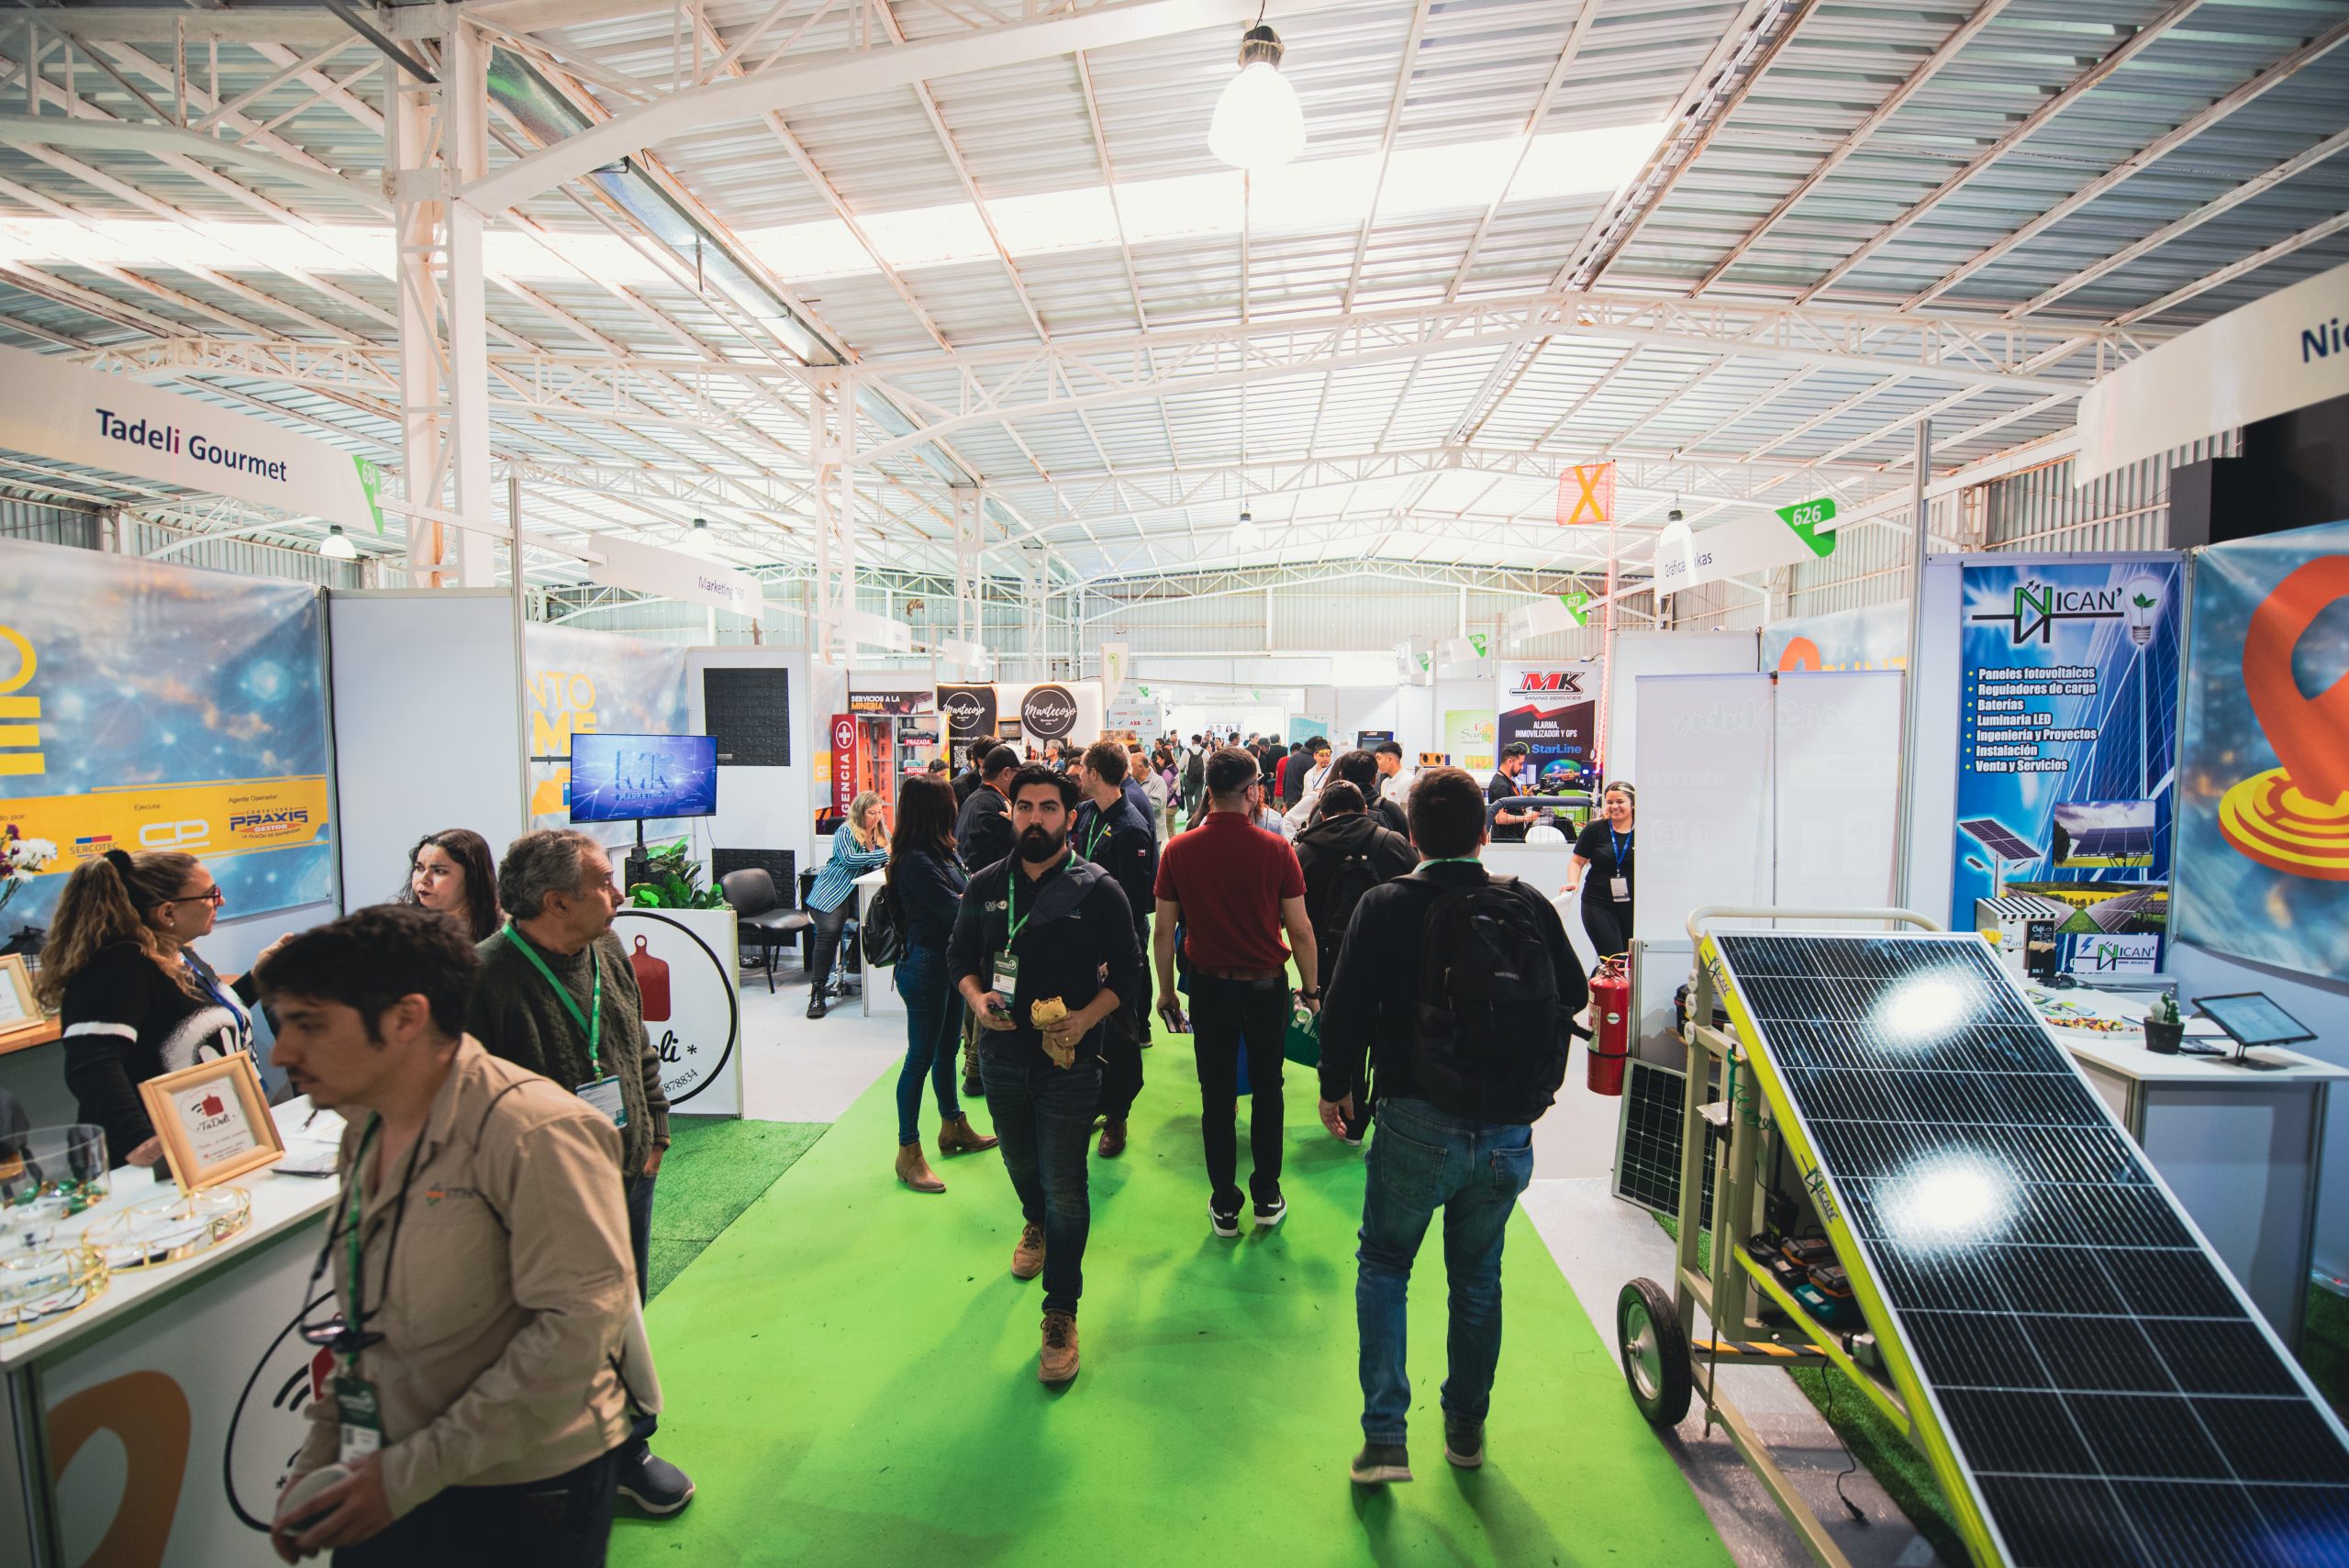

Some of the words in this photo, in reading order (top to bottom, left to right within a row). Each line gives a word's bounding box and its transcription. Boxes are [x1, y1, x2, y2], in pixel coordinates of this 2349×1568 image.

[95, 407, 181, 454] Tadeli
[187, 435, 287, 482] Gourmet
[1793, 505, 1821, 526] 626
[698, 575, 733, 601] Marketing
[1567, 595, 1580, 607] 627
[2013, 586, 2122, 644] NICAN'
[1978, 669, 2022, 680] Paneles
[2024, 667, 2096, 680] fotovoltaicos
[1521, 672, 1586, 693] MK
[1977, 684, 2047, 696] Reguladores
[2049, 682, 2063, 695] de
[2065, 683, 2097, 695] carga
[943, 703, 985, 717] Mantecoso
[1025, 703, 1076, 718] Mantecoso
[1977, 698, 2024, 711] Baterías
[1533, 720, 1560, 730] ALARMA,
[1976, 714, 2031, 726] Luminaria
[2033, 713, 2052, 726] LED
[1515, 729, 1560, 738] INMOVILIZADOR
[1561, 729, 1565, 738] Y
[1565, 729, 1577, 738] GPS
[1976, 729, 2033, 742] Ingeniería
[2035, 731, 2042, 741] y
[2043, 728, 2098, 741] Proyectos
[1531, 743, 1583, 753] StarLine
[1976, 744, 2038, 757] Instalación
[1975, 760, 2008, 772] Venta
[2009, 762, 2016, 773] y
[2017, 759, 2068, 771] Servicios
[840, 753, 851, 817] GENCIA
[230, 810, 308, 831] PRAXIS
[254, 824, 288, 832] GESTOR
[69, 842, 118, 855] SERCOTEC
[2097, 943, 2155, 971] NICAN'
[662, 1068, 698, 1093] 878834
